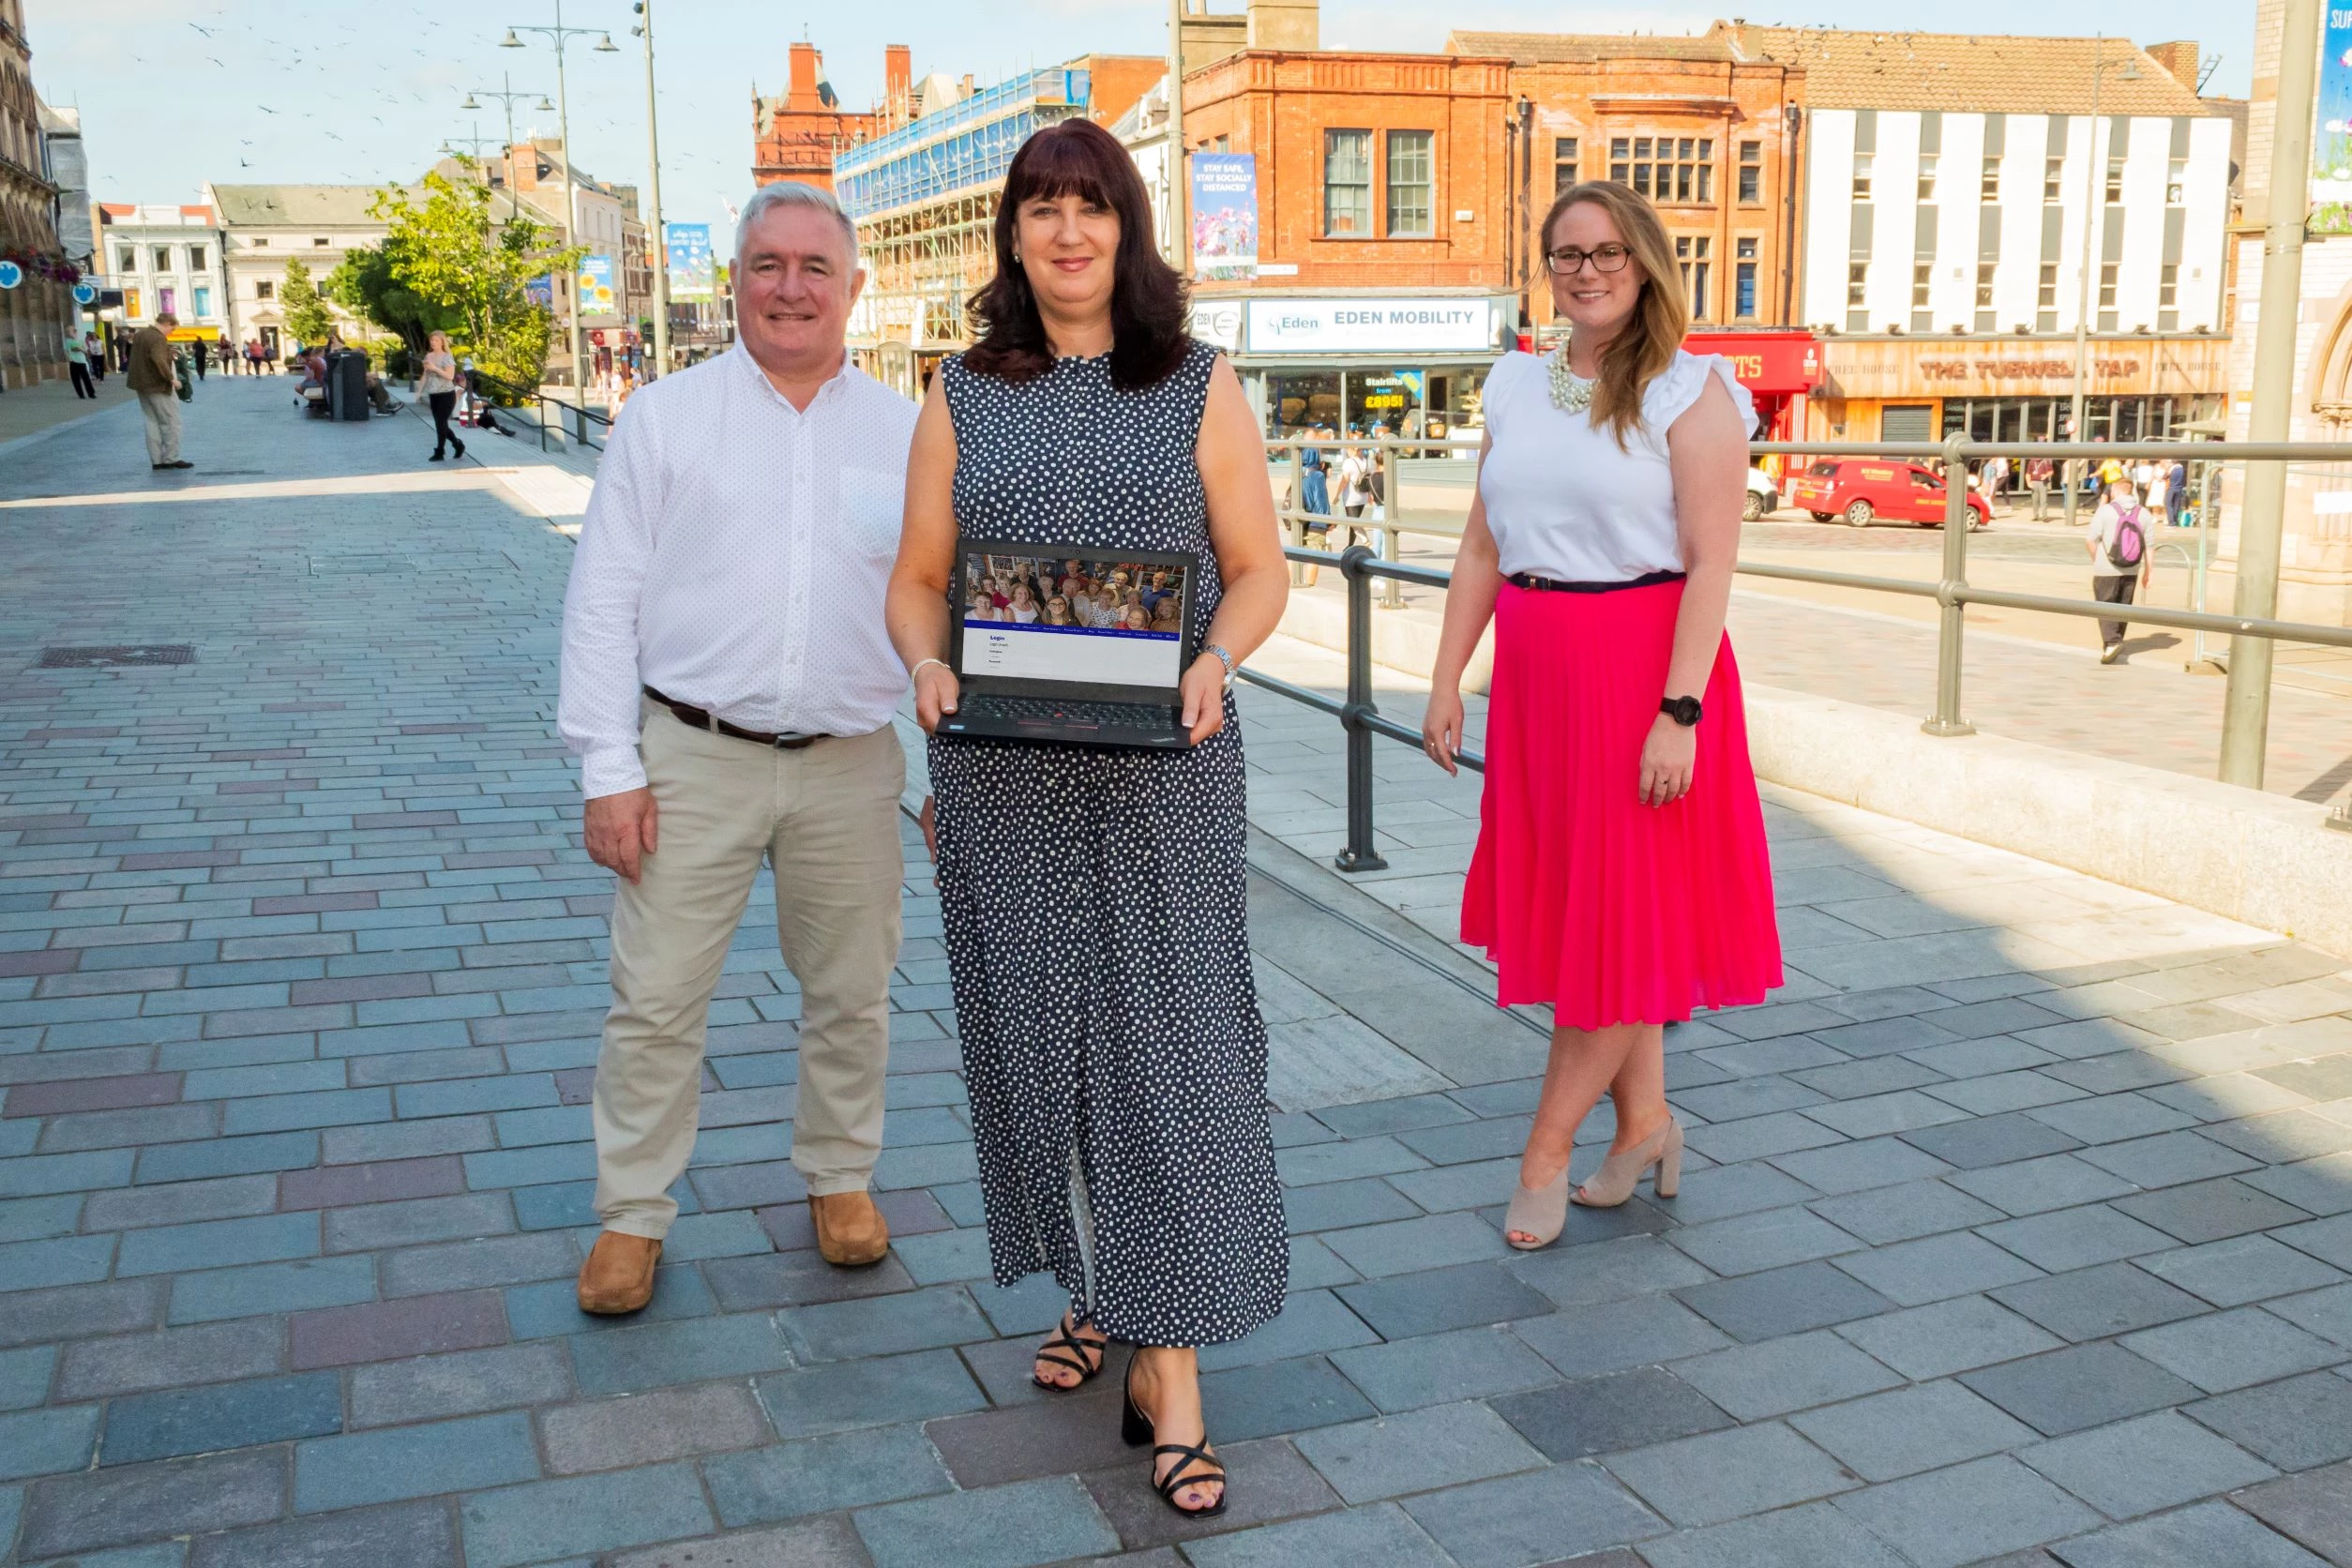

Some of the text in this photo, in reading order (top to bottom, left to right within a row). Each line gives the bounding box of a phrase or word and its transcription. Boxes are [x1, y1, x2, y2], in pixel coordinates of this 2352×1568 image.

[1203, 164, 1221, 173] STAY
[1196, 173, 1252, 182] STAY SOCIALLY
[1202, 183, 1246, 191] DISTANCED
[1334, 311, 1473, 324] EDEN MOBILITY
[1282, 317, 1319, 329] Eden
[1862, 364, 1899, 374] HOUSE
[1920, 360, 1968, 380] THE
[2094, 359, 2140, 378] TAP
[2155, 362, 2222, 371] FREE HOUSE
[1365, 377, 1403, 386] Stairlifts
[1365, 395, 1404, 409] £895!
